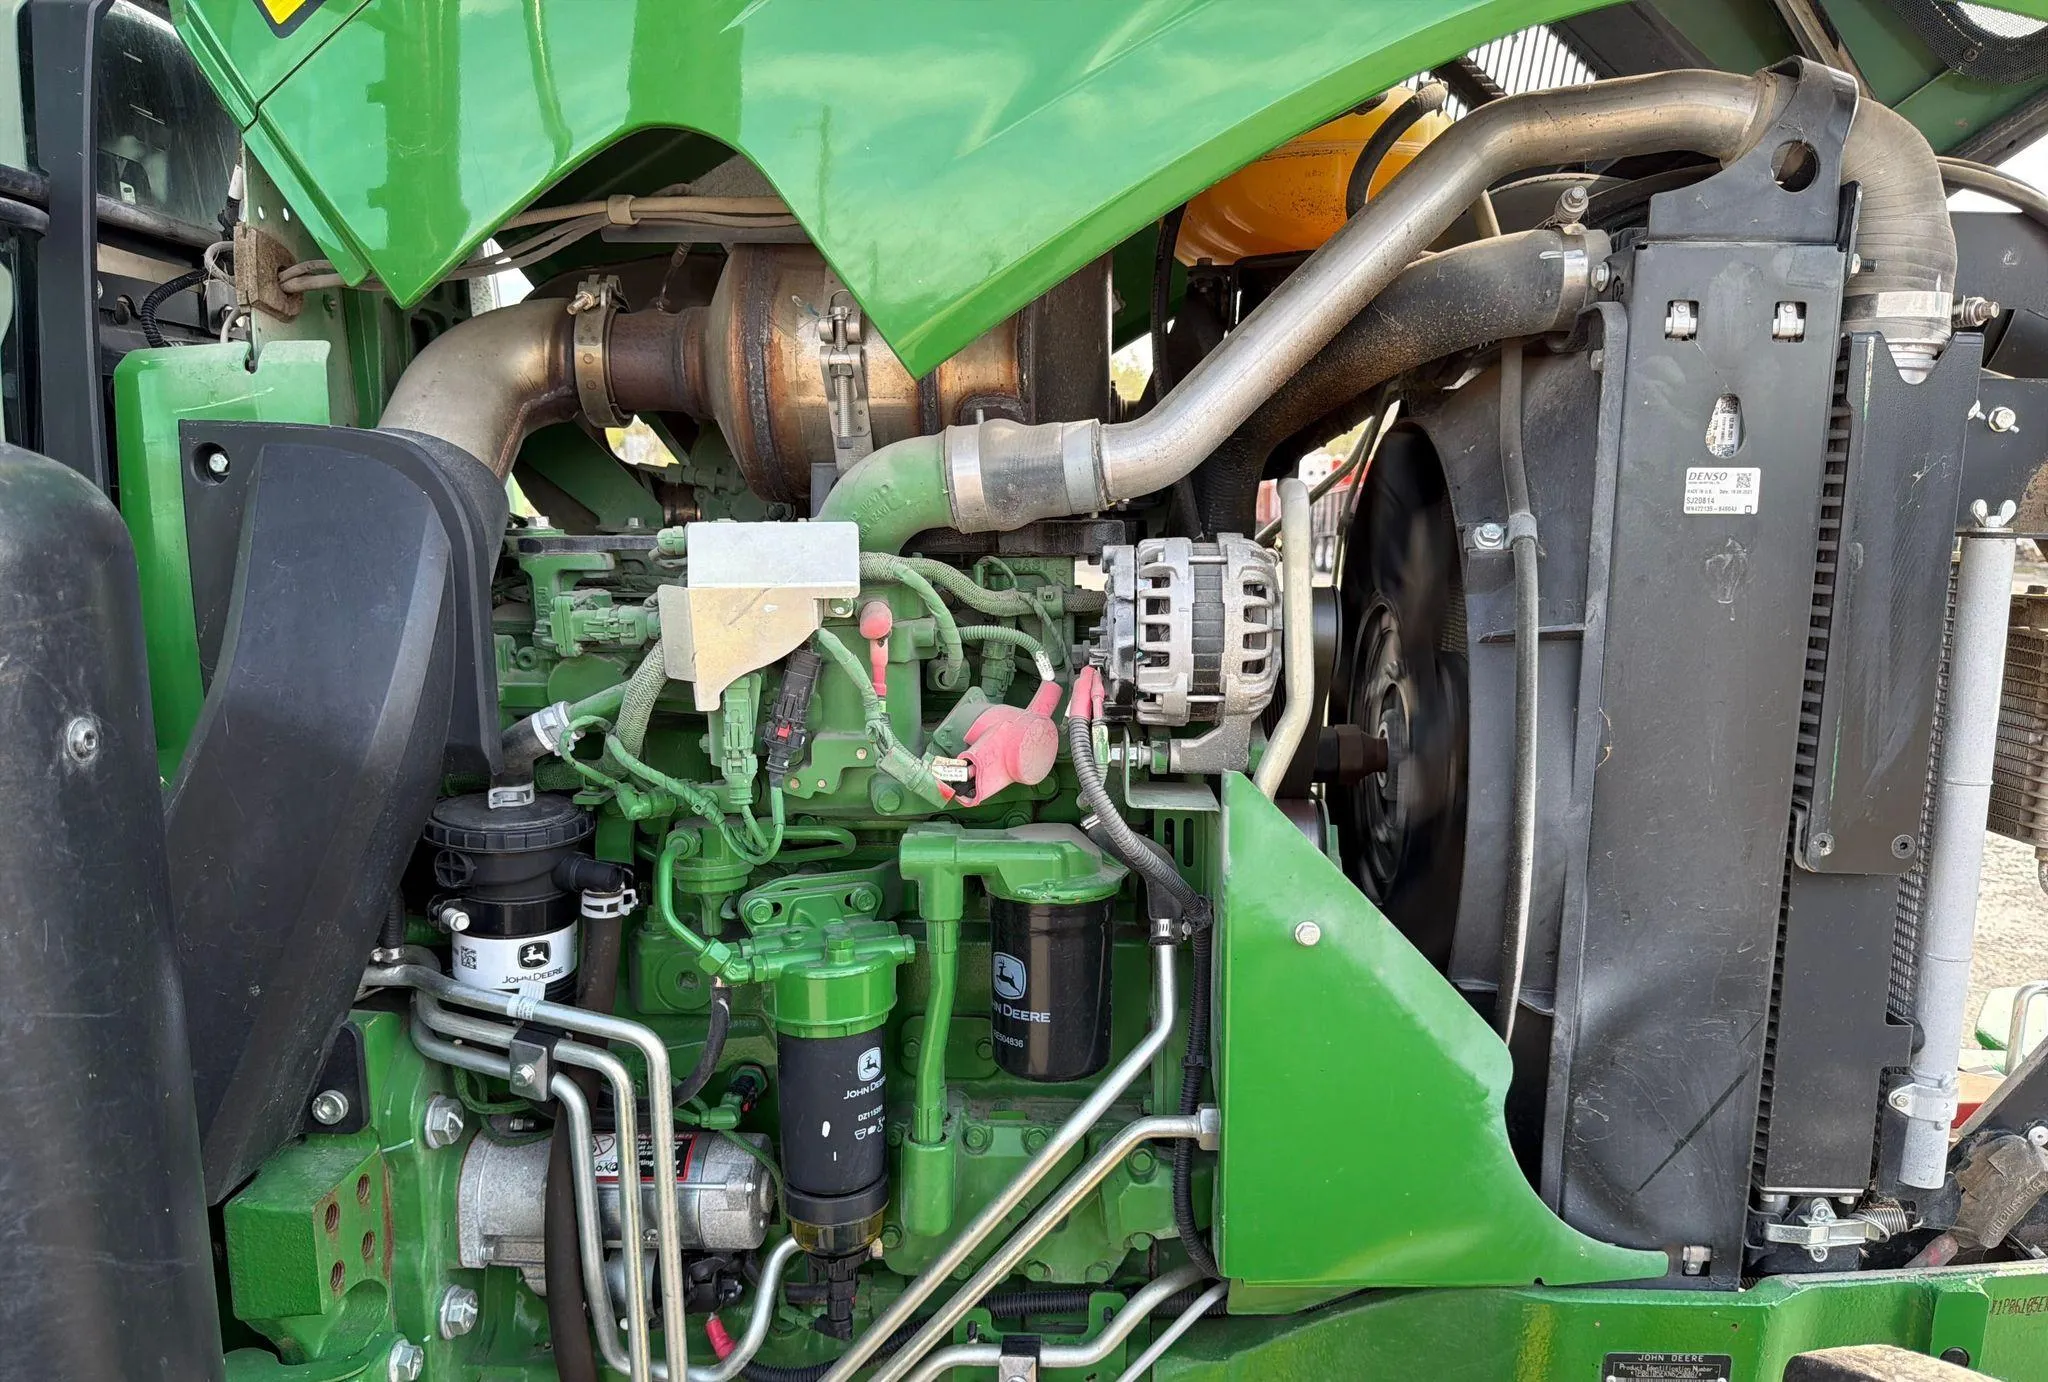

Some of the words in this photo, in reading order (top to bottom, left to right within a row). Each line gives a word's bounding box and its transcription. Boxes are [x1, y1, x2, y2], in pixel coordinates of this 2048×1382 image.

[1688, 472, 1728, 481] DENSO
[533, 966, 564, 980] DEERE
[1003, 1003, 1051, 1023] DEERE
[843, 1086, 870, 1100] JOHN
